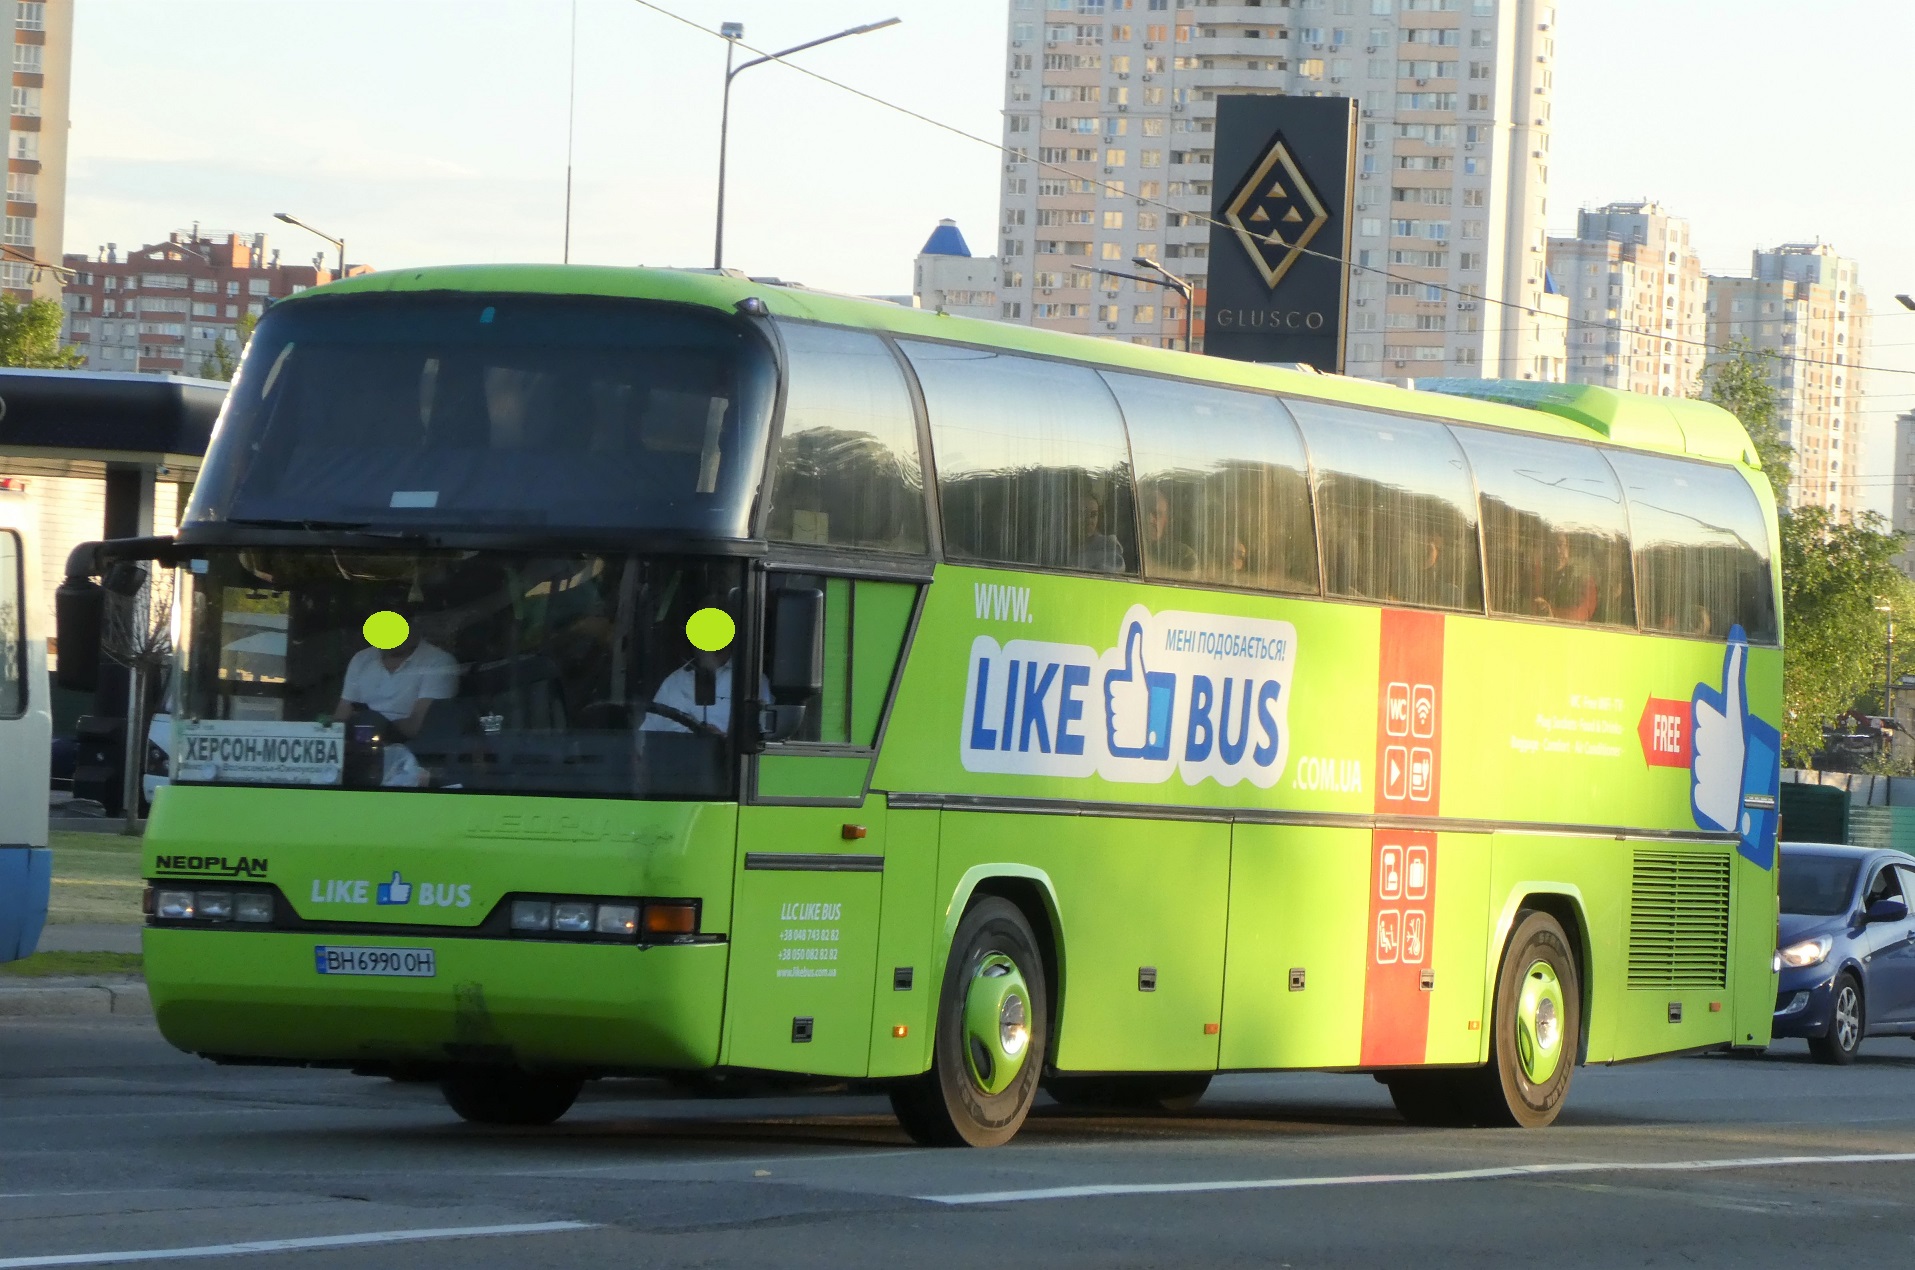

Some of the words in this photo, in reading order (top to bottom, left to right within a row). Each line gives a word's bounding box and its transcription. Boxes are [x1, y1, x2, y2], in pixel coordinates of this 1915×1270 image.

[1217, 309, 1324, 329] GLUSCO
[1165, 628, 1196, 653] МЕНІ
[1197, 631, 1287, 661] ПОДОБАЄТЬСЯ!
[970, 657, 1091, 756] LIKE
[1184, 674, 1281, 767] BUS
[1390, 698, 1407, 721] WC
[1653, 714, 1681, 753] FREE
[186, 737, 339, 764] ХЕРСОН-МОСКВА
[1292, 756, 1362, 793] .COM.UA
[156, 855, 268, 876] NEOPLAN
[311, 880, 370, 904] LIKE
[418, 883, 472, 907] BUS
[780, 903, 799, 920] LLC
[799, 903, 821, 920] LIKE
[821, 903, 842, 920] BUS
[327, 951, 355, 971] BH
[358, 952, 401, 971] 6990
[404, 953, 431, 972] OH
